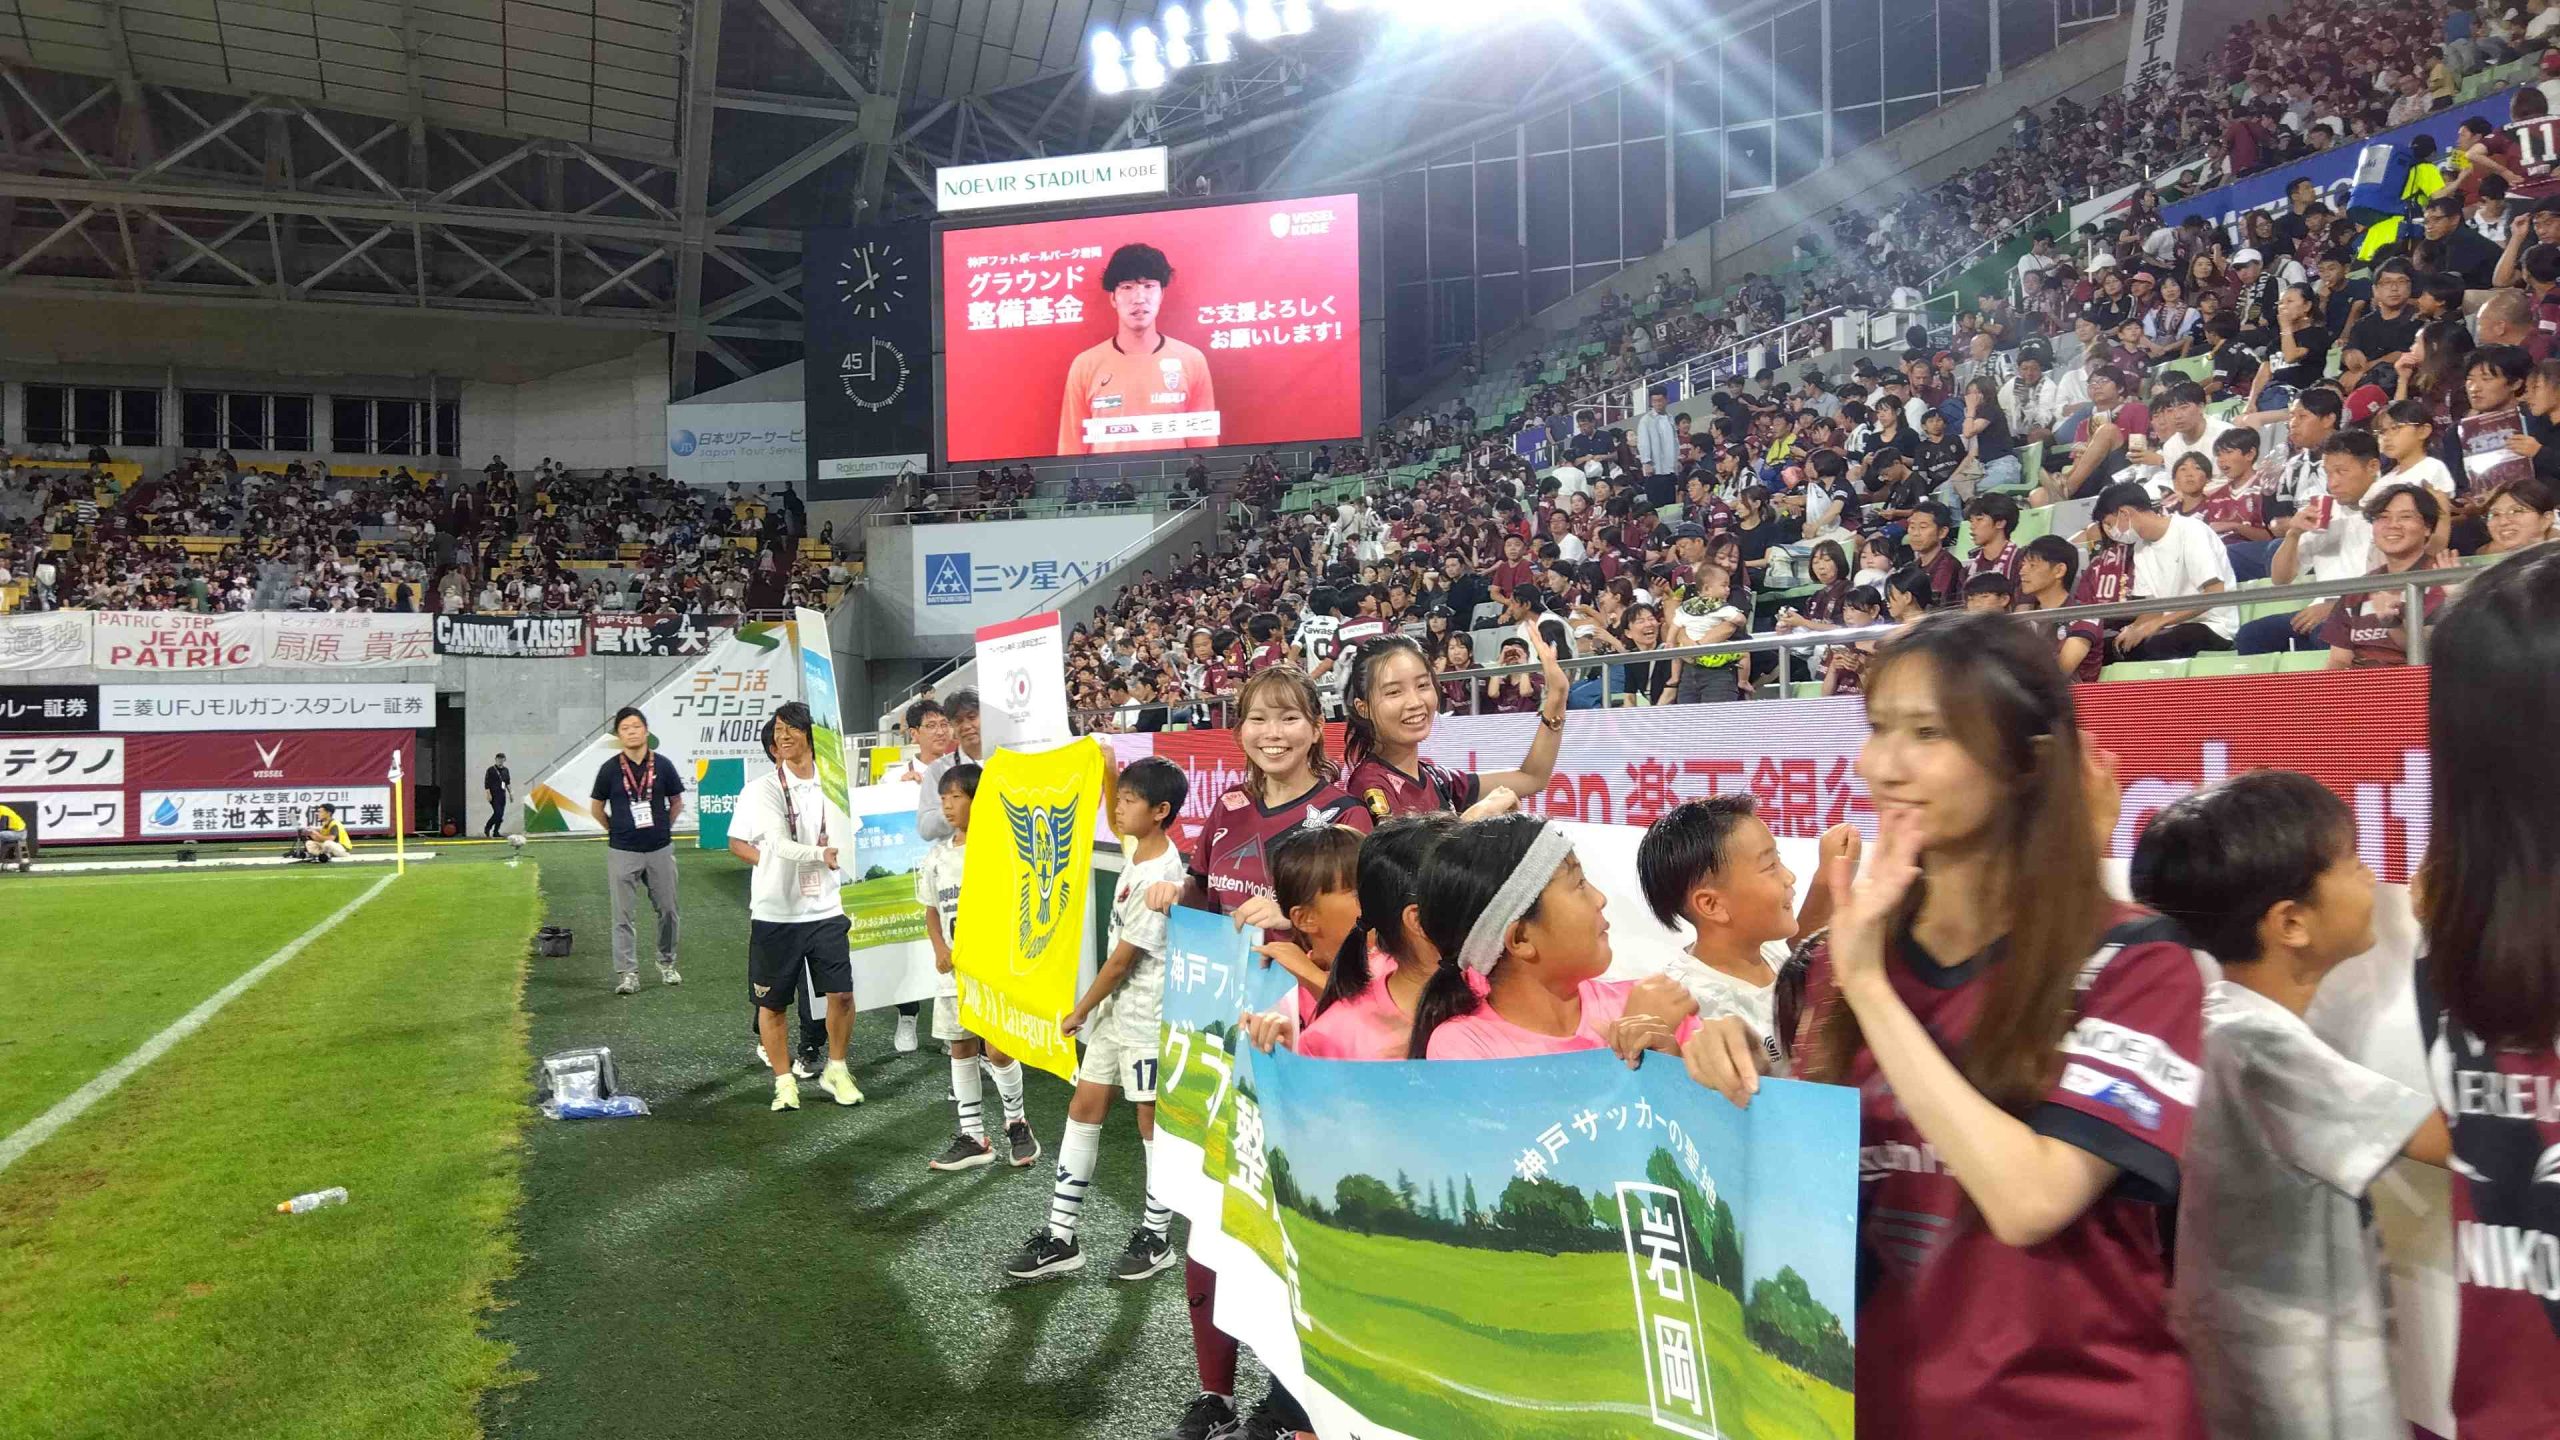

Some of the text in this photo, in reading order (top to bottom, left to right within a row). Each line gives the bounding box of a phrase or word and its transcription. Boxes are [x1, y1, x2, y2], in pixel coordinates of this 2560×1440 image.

[2516, 122, 2558, 166] 11
[944, 163, 1158, 197] NOEVIR STADIUM KOBE
[1291, 210, 1336, 224] VISSEL
[1291, 222, 1329, 236] KOBE
[967, 265, 1085, 298] グラウンド
[967, 293, 1084, 331] 整備基金
[1197, 295, 1337, 325] ご支援よろしく
[841, 352, 863, 371] 45
[699, 429, 806, 446] 日本ツアーサービ
[700, 447, 736, 458] Japan
[740, 447, 766, 456] Tour
[836, 461, 878, 474] Rakuten
[973, 559, 1127, 592] 三ツ星ベル
[2096, 574, 2117, 598] 10
[99, 612, 215, 629] PATRIC STEP
[437, 615, 583, 649] CANNON TAISEI
[140, 631, 220, 647] JEAN
[270, 629, 434, 663] 扇原 貴宏
[593, 626, 653, 653] 宮代
[2350, 627, 2389, 642] ISSEL
[110, 643, 250, 668] PATRIC
[693, 665, 770, 692] デコ活
[700, 719, 765, 743] IN KOBE
[4, 748, 115, 777] テクノ
[253, 770, 284, 778] VISSEL
[44, 803, 116, 828] ソーワ
[192, 808, 218, 819] 株式
[192, 819, 218, 830] 会社
[221, 803, 385, 829] 池本設備工業
[1132, 1057, 1158, 1091] 17
[1513, 1096, 1717, 1212] 神戸サッカーの聖地
[1640, 1205, 1703, 1416] 岩岡
